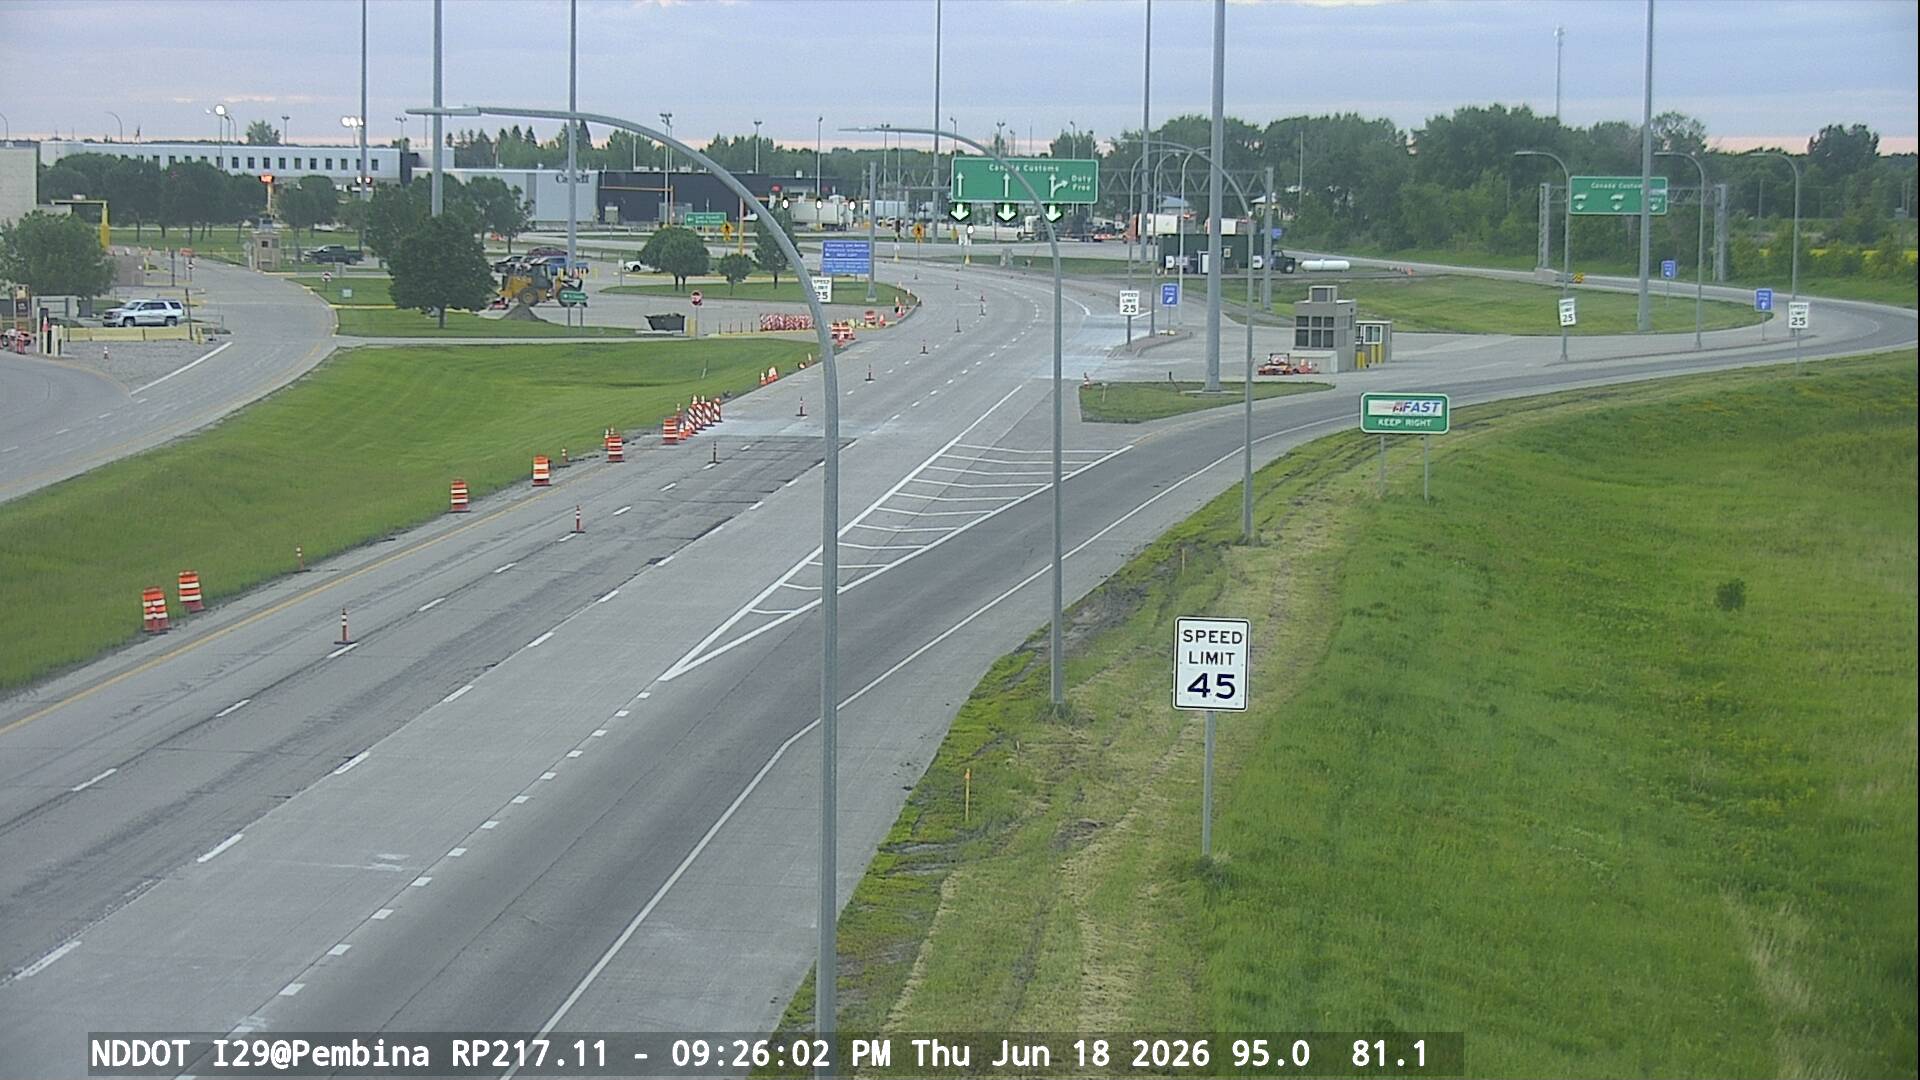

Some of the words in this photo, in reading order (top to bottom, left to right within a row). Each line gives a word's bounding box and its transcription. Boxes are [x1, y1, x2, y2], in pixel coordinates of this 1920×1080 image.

[989, 163, 1020, 172] Cana
[1023, 164, 1060, 172] Customs
[1071, 174, 1092, 184] Duty
[1072, 183, 1091, 191] Free
[1590, 181, 1616, 189] Canada
[815, 291, 829, 300] 25
[1122, 304, 1137, 313] 25
[1562, 313, 1573, 323] 25
[1791, 317, 1806, 326] 25
[1402, 401, 1441, 413] FAST
[1378, 418, 1401, 427] KEEP
[1405, 418, 1432, 427] RIGHT
[1183, 629, 1243, 644] SPEED
[1188, 651, 1236, 665] LIMIT
[1187, 672, 1236, 699] 45
